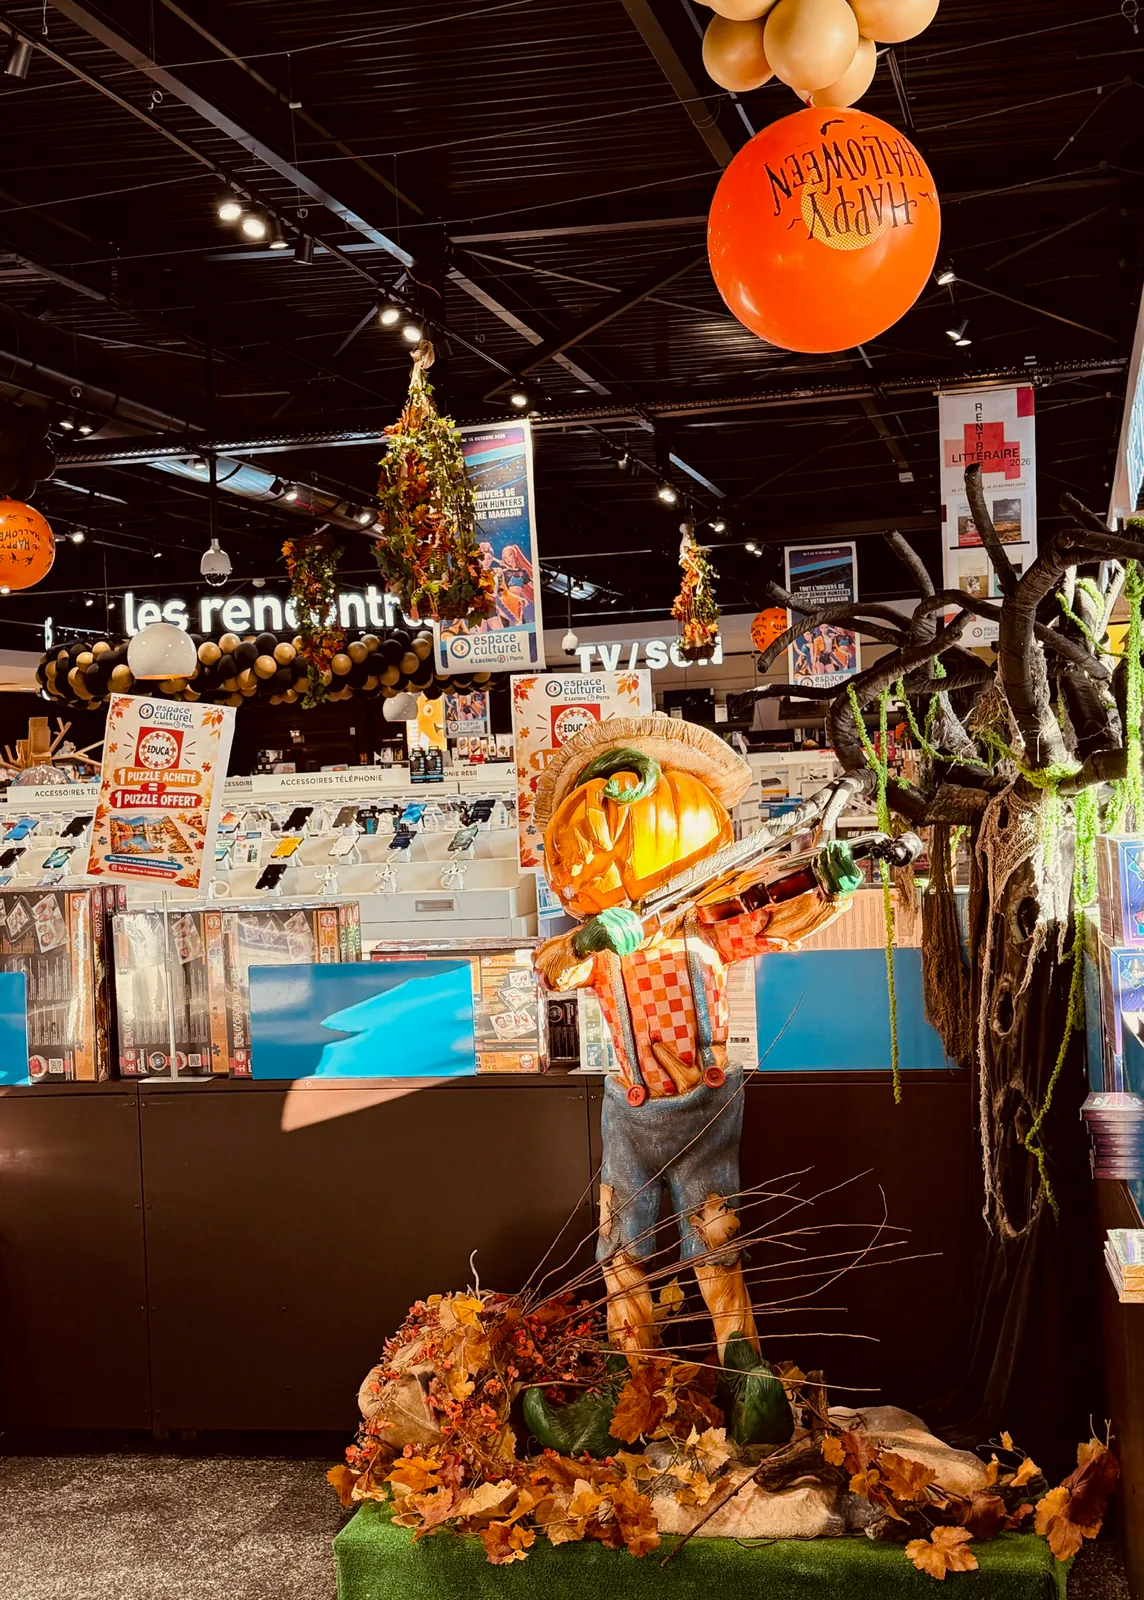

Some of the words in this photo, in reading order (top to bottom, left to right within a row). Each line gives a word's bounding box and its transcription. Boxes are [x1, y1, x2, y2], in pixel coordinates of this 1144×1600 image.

[764, 135, 925, 217] HALLOWEEN
[807, 180, 918, 241] HAPPY
[952, 448, 1020, 463] LITTÉRAIRE
[1010, 458, 1031, 466] 2026
[505, 488, 516, 496] DE
[490, 498, 522, 508] HUNTERS
[488, 508, 522, 519] MAGASIN
[124, 592, 188, 636] les
[474, 633, 516, 644] espace
[474, 643, 522, 655] culturel
[564, 678, 601, 688] espace
[564, 684, 606, 695] culturel
[156, 705, 190, 714] espace
[154, 710, 192, 722] culturel
[147, 745, 170, 756] EDUCA
[118, 769, 126, 784] 1
[128, 772, 160, 782] PUZZLE
[163, 772, 197, 784] ACHETÉ
[281, 776, 333, 786] ACCESSOIRES
[335, 774, 383, 783] TÉLÉPHONIE
[35, 789, 85, 797] ACCESSOIRES
[115, 791, 122, 807] 1
[124, 794, 158, 805] PUZZLE
[160, 796, 197, 806] OFFERT
